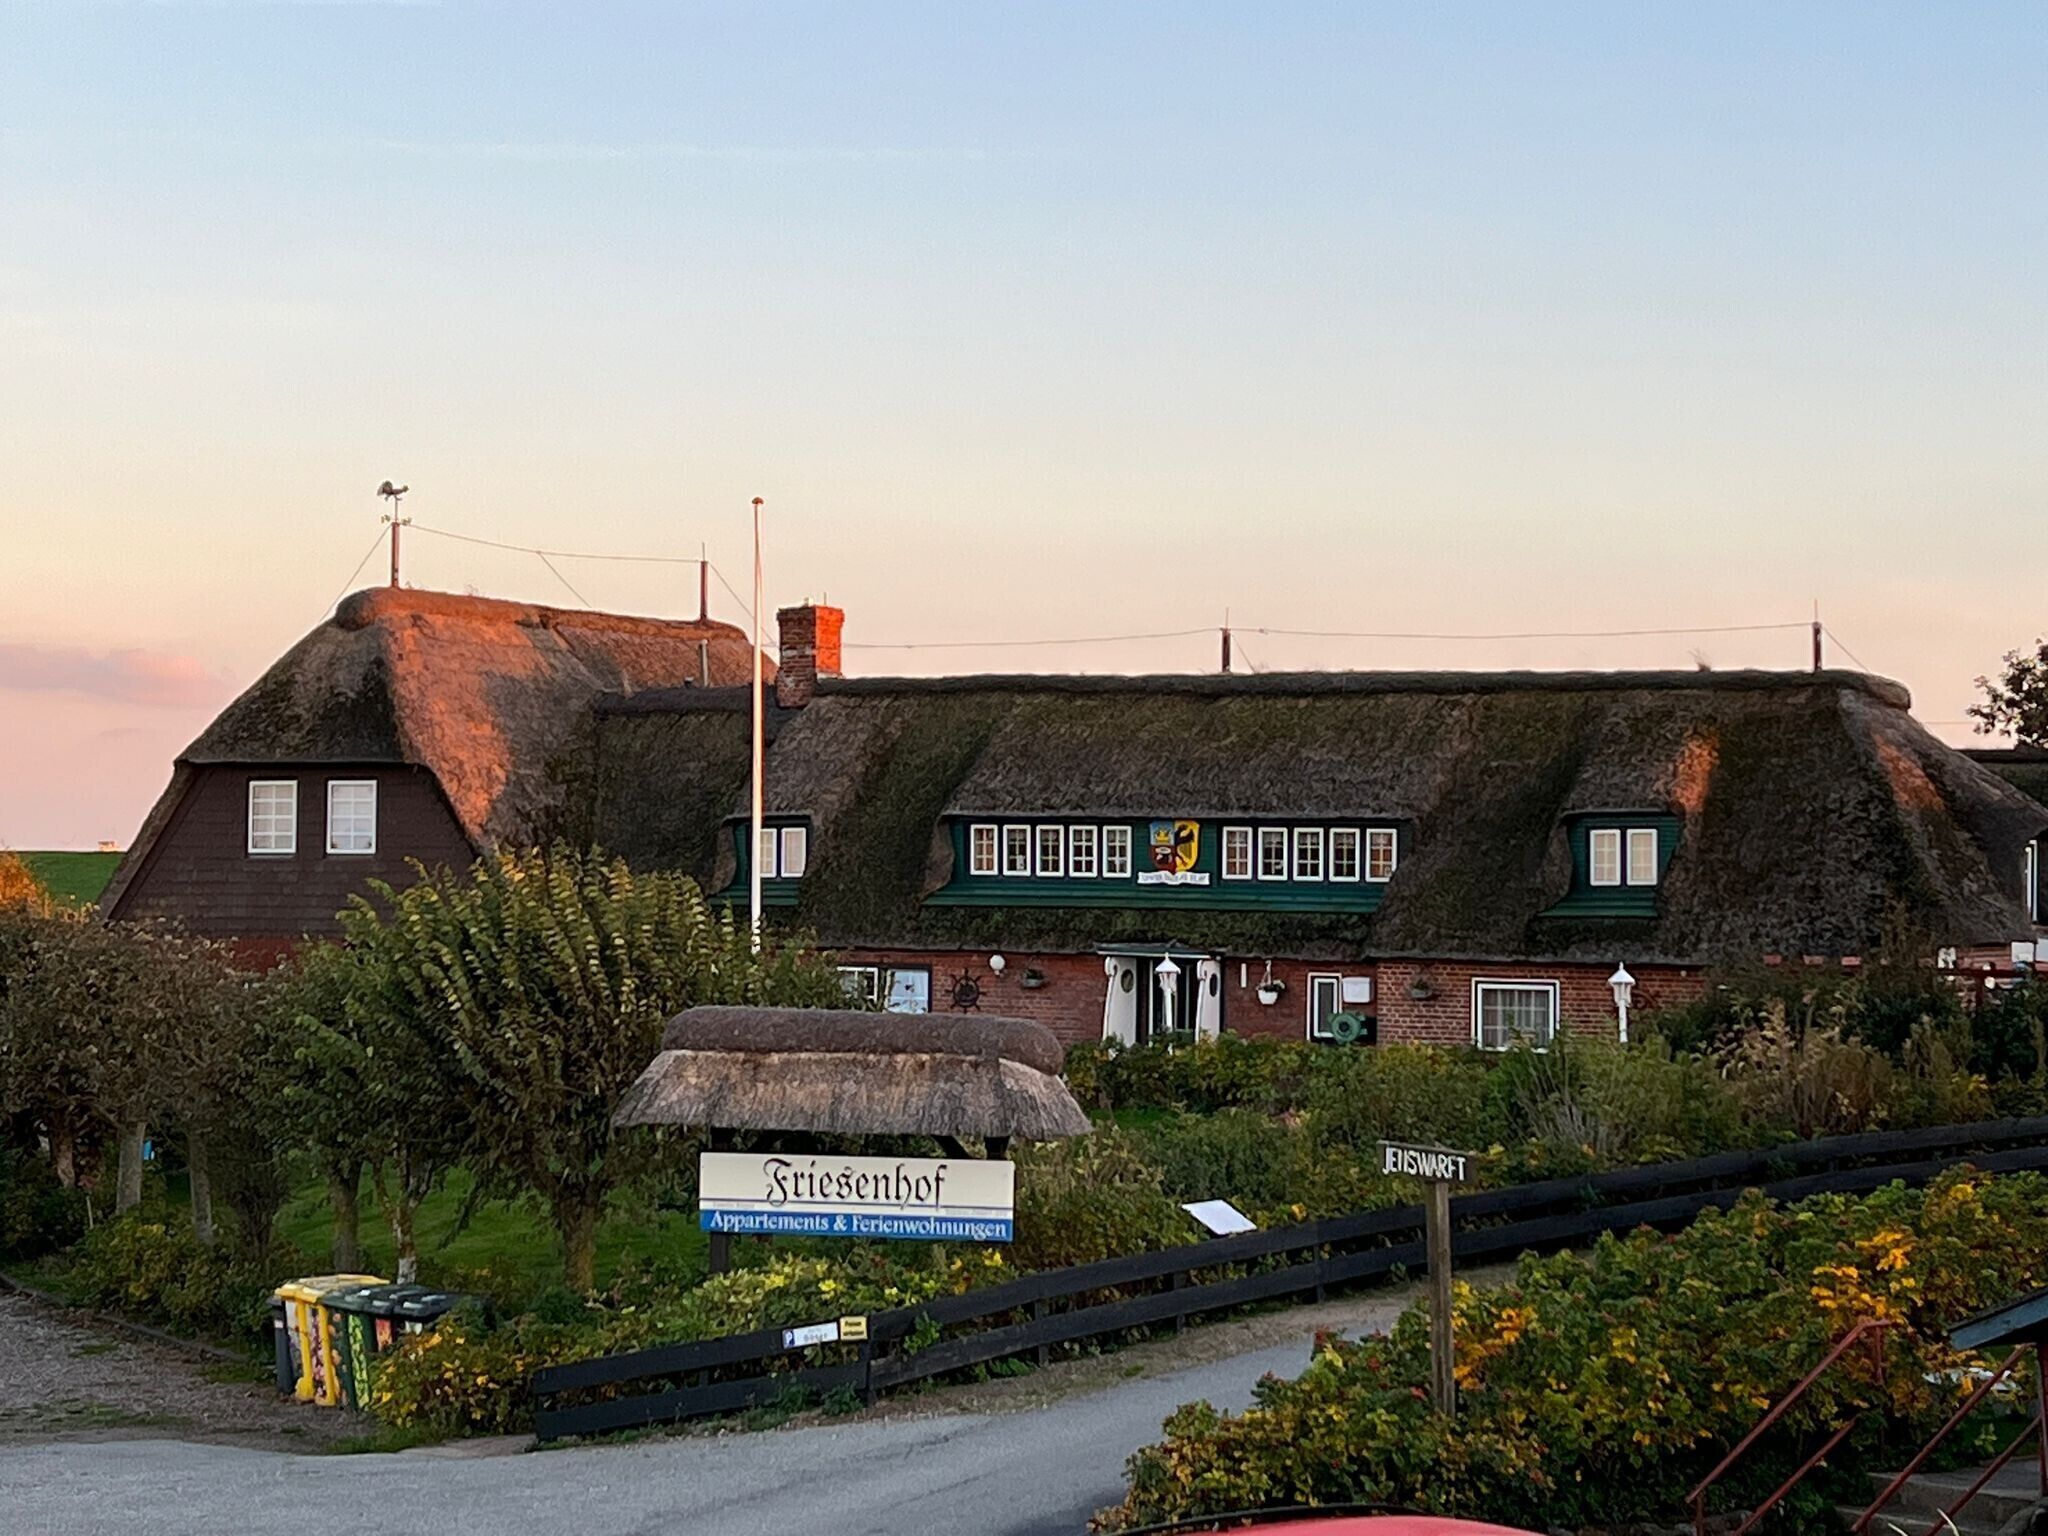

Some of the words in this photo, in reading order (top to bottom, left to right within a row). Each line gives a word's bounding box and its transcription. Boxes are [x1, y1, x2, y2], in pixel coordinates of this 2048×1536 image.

[763, 1157, 948, 1210] Friesenhof
[709, 1210, 829, 1233] Appartements
[833, 1214, 848, 1231] &
[851, 1214, 1007, 1241] Ferienwohnungen
